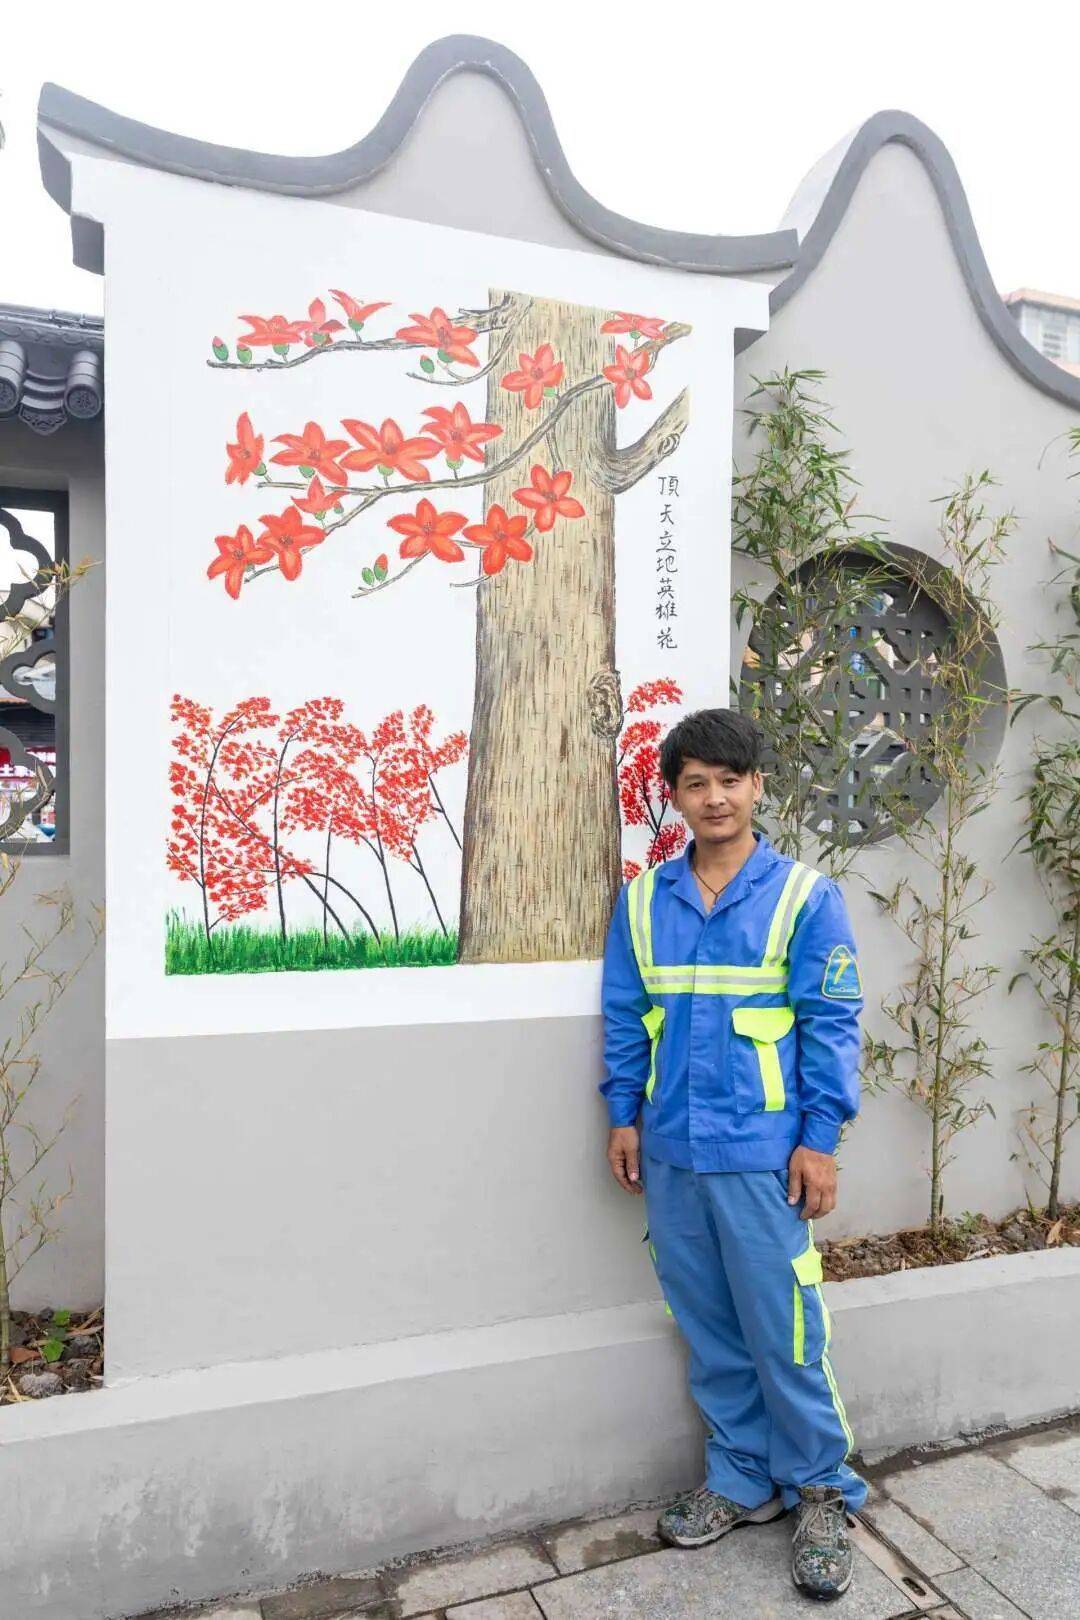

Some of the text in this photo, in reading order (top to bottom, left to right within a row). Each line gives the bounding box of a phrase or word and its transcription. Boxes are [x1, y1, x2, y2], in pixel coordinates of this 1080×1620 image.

[655, 475, 680, 649] 頂天立地英雄花
